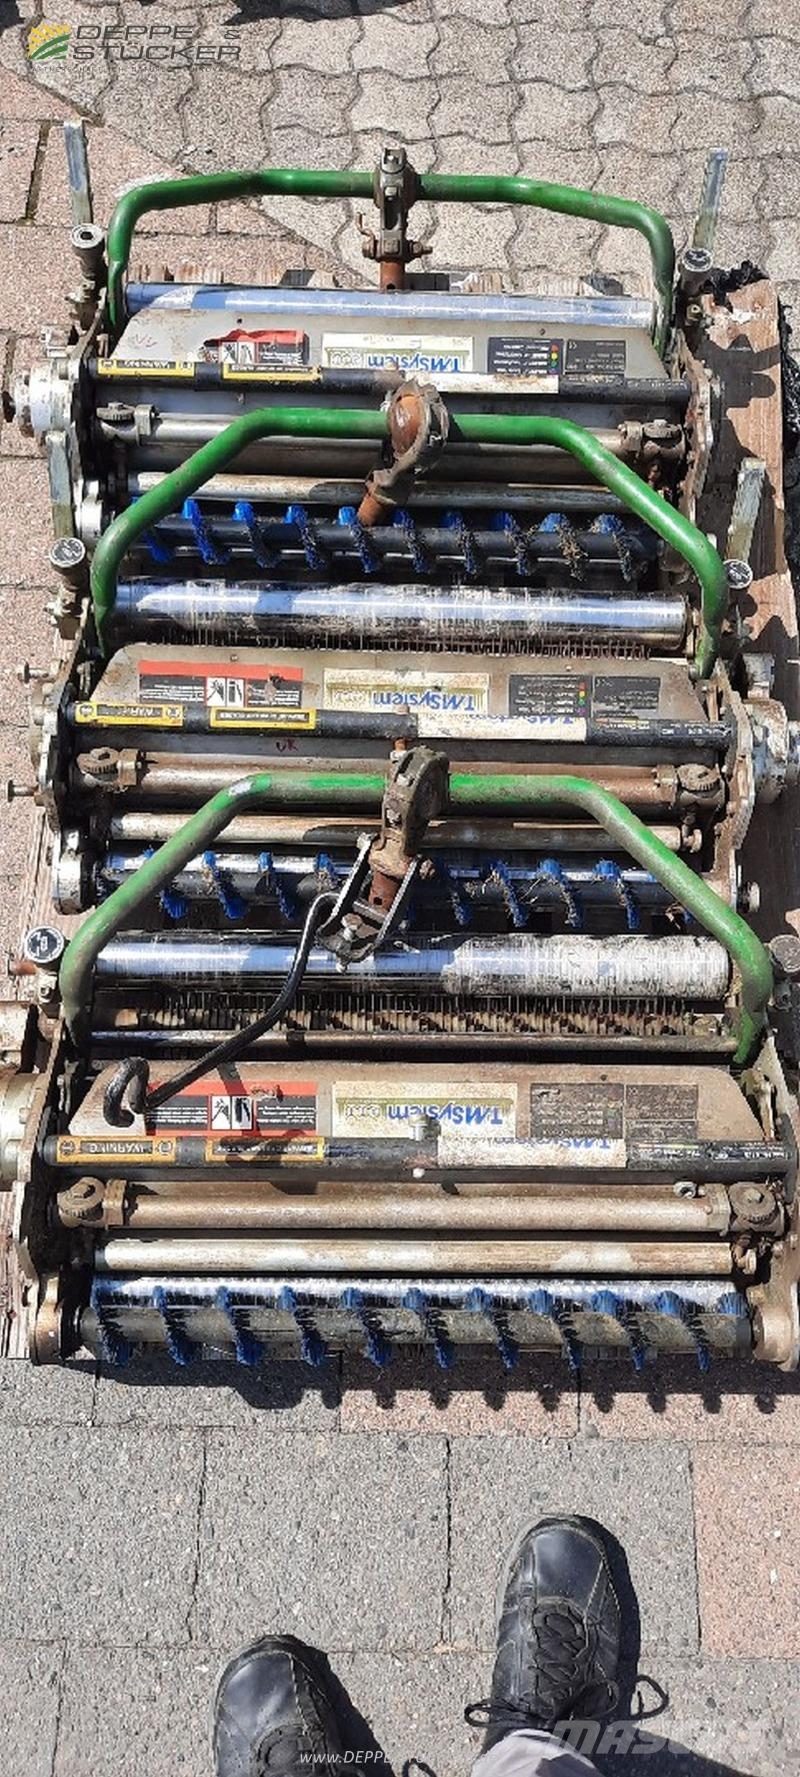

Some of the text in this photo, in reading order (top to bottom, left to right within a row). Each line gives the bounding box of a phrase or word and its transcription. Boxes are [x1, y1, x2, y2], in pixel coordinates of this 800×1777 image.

[368, 353, 461, 372] TMSystem
[373, 691, 475, 711] TMSystem
[388, 1102, 504, 1125] TMSystem
[89, 1142, 144, 1153] WARNING
